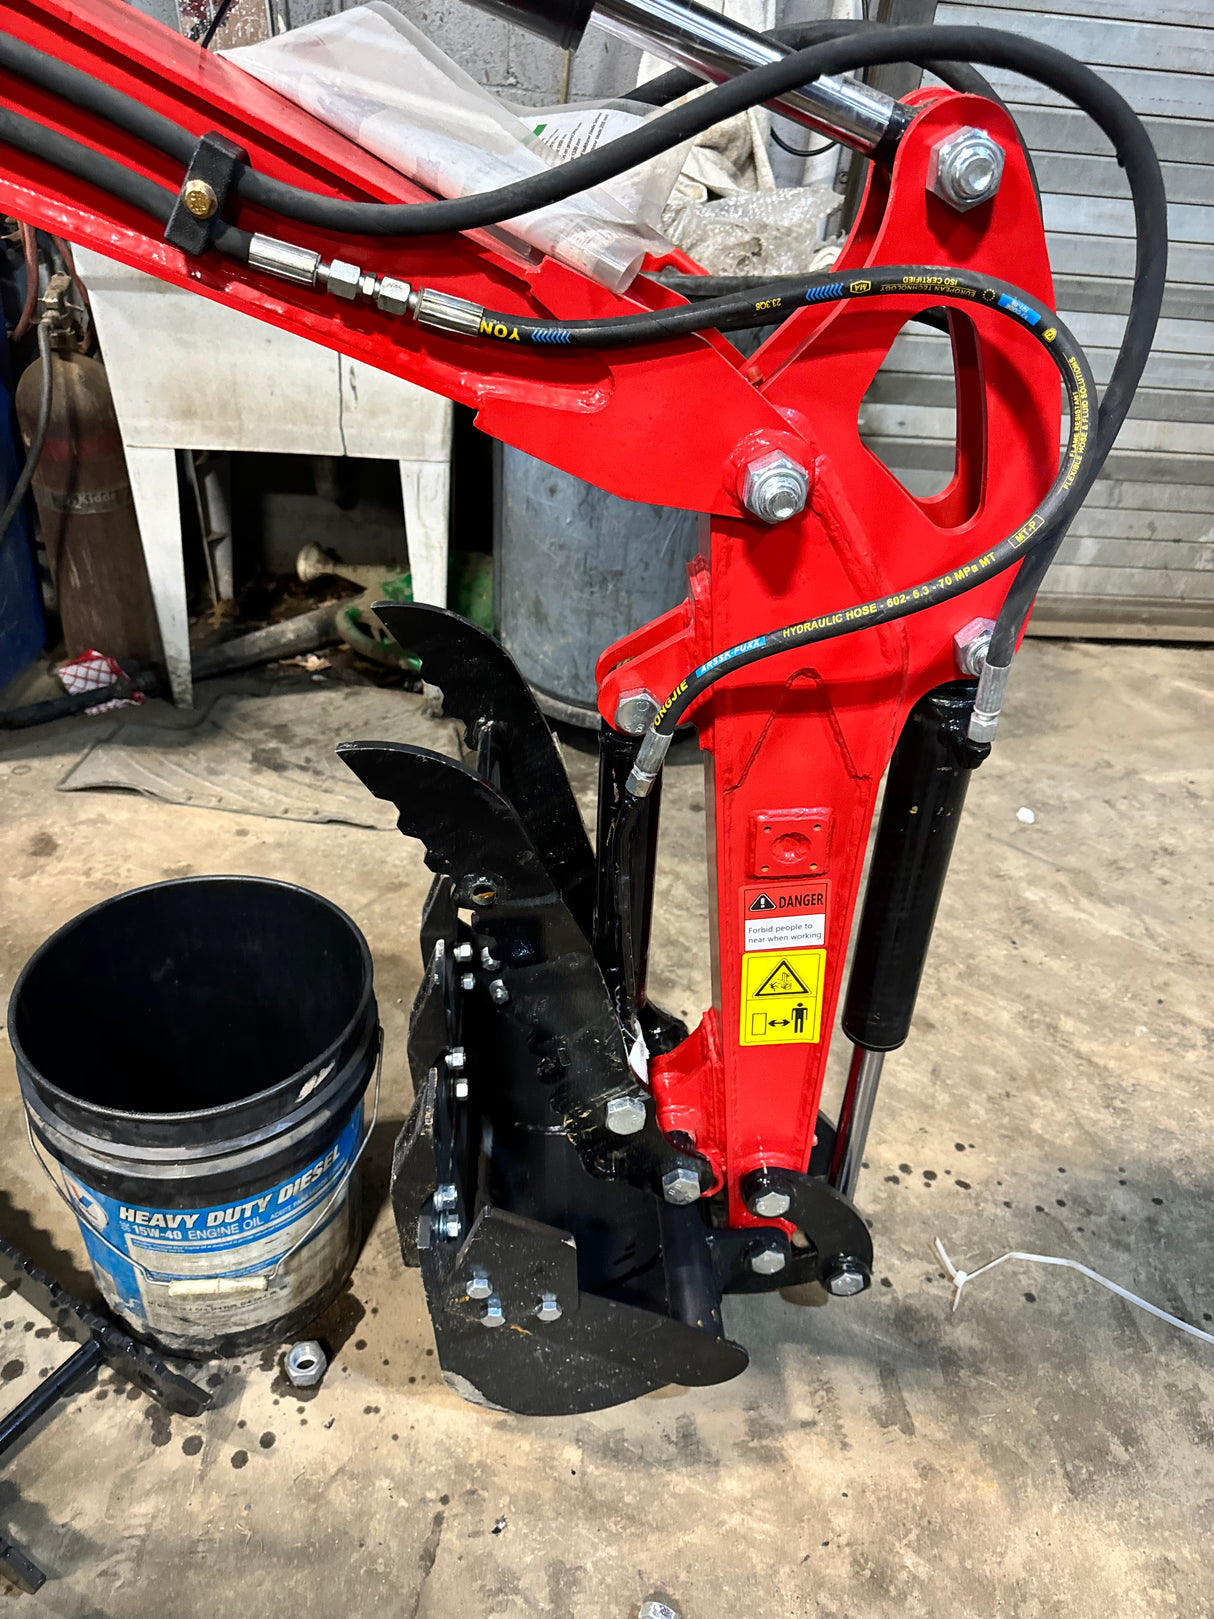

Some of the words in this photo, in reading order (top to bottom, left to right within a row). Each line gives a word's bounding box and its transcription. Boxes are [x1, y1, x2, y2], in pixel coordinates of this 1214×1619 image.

[879, 283, 934, 292] TECHNOLOGY
[902, 276, 943, 285] CERTIFIED
[935, 284, 977, 298] EUROPEAN
[944, 277, 958, 287] ISO
[1068, 356, 1088, 399] SOLUTIONS
[1073, 391, 1081, 431] RESISTANT
[1081, 400, 1089, 423] FLUID
[1069, 432, 1080, 458] FLAME
[1078, 432, 1088, 453] HOSE
[1063, 455, 1082, 490] FLEXIBLE
[1014, 520, 1038, 543] MT-P
[782, 613, 843, 638] HYDRAULIC
[846, 603, 878, 621] HOSE
[912, 586, 930, 600] 6.3
[938, 576, 953, 589] 70
[954, 563, 979, 582] MPa
[979, 551, 997, 568] MT
[778, 892, 824, 909] DANGER
[748, 925, 774, 934] Forbid
[775, 923, 803, 933] people
[748, 936, 766, 944] near
[767, 934, 789, 942] when
[790, 932, 822, 940] working
[119, 1206, 200, 1229] HEAVY
[206, 1193, 273, 1227] DUTY
[277, 1143, 340, 1205] DIESEL
[132, 1224, 182, 1240] 15W-40
[188, 1222, 240, 1240] ENGINE
[243, 1215, 265, 1230] OIL
